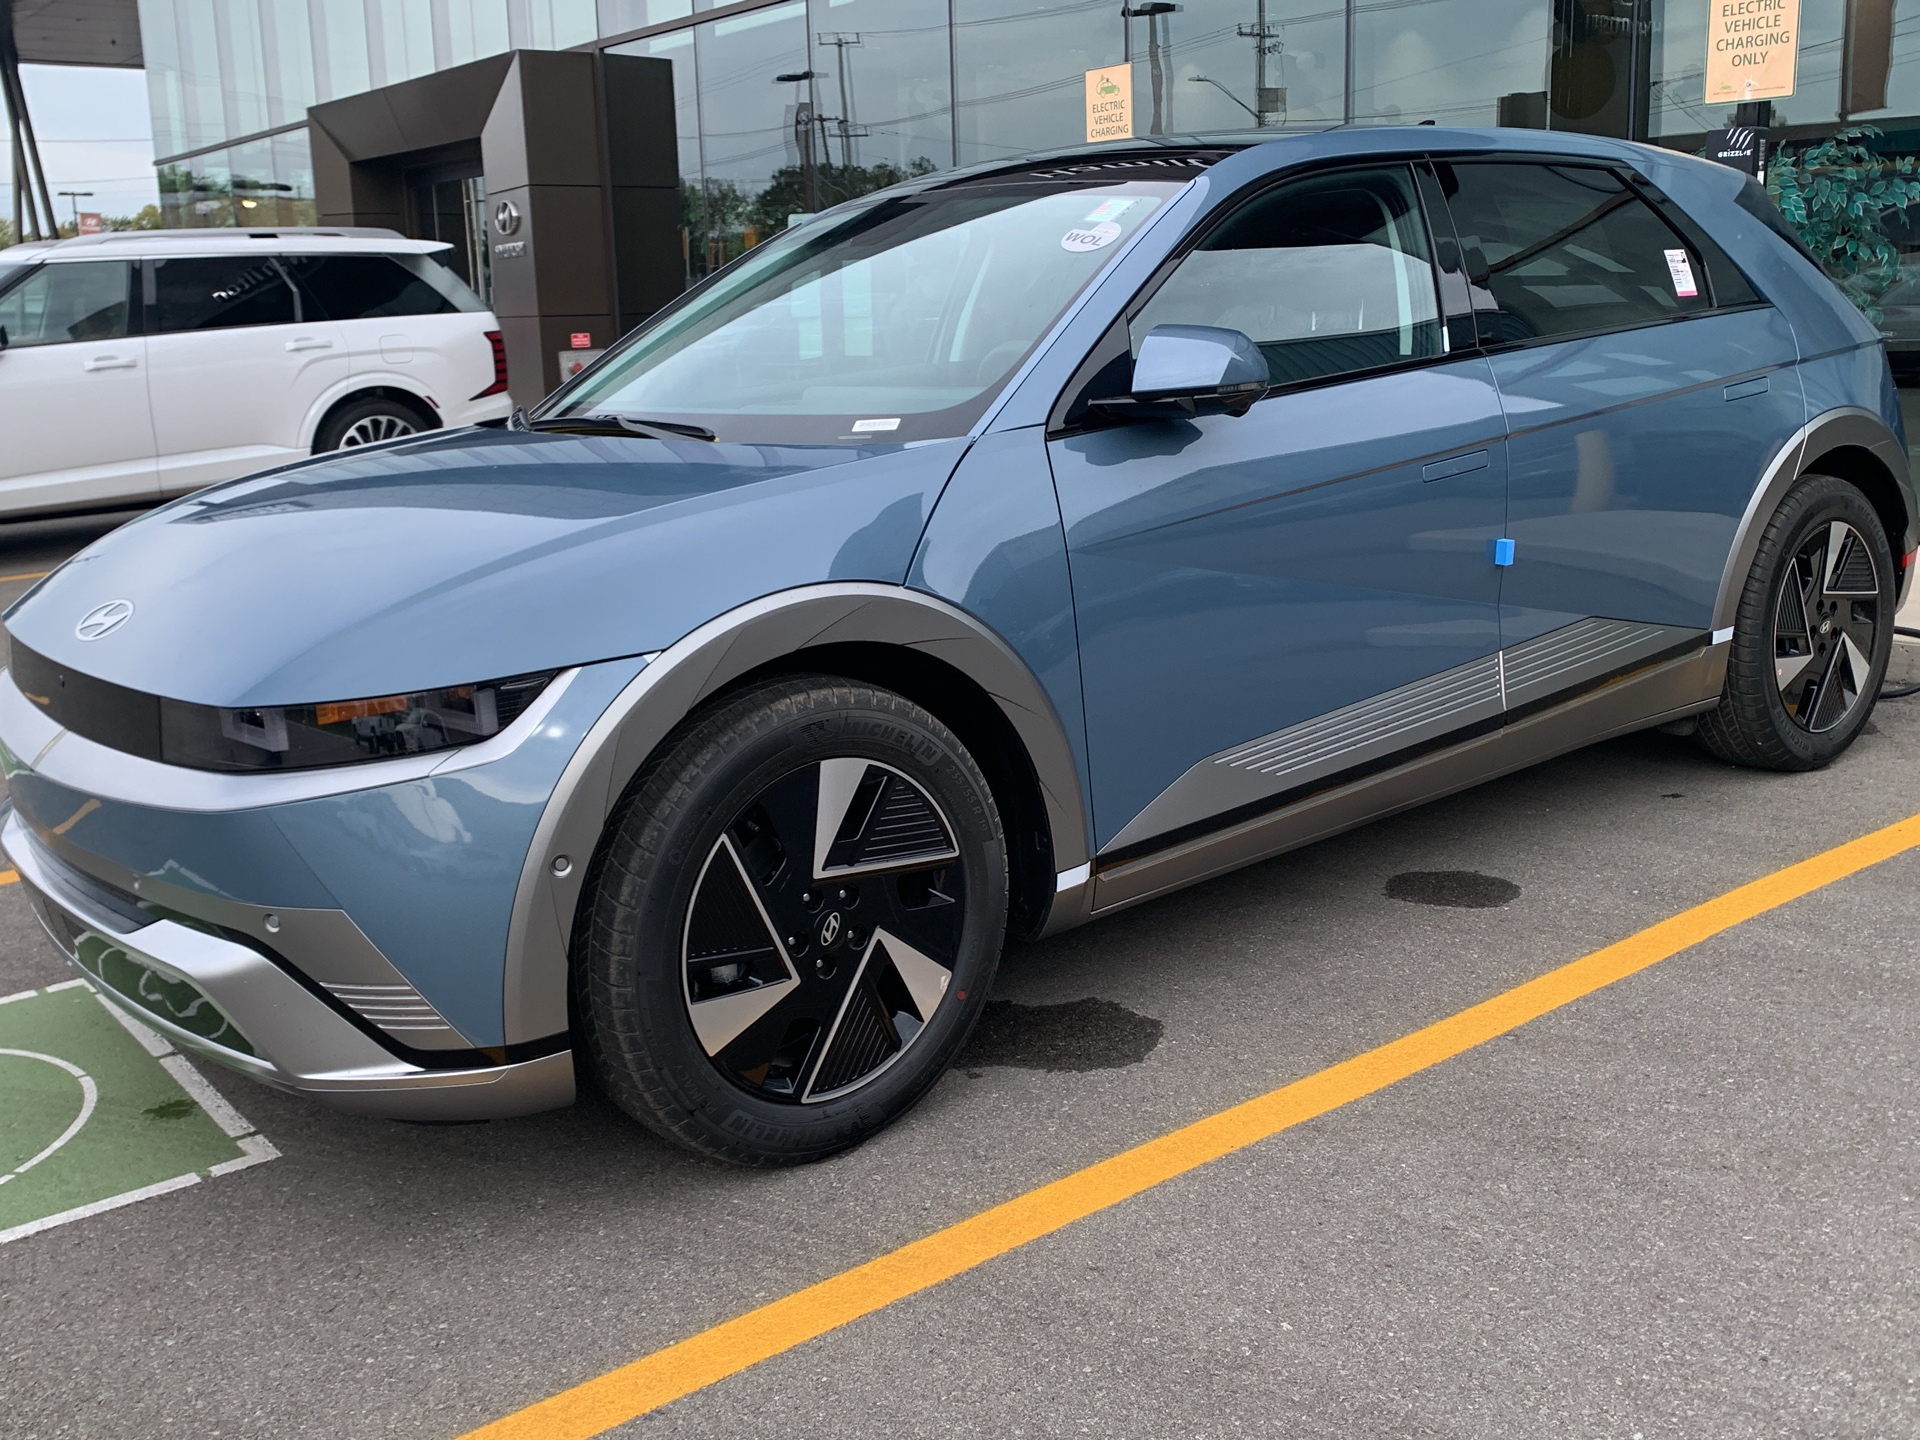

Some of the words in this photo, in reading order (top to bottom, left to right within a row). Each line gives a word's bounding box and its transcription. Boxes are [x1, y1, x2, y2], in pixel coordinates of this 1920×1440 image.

[1722, 0, 1785, 17] ELECTRIC
[1724, 14, 1781, 33] VEHICLE
[1716, 31, 1790, 51] CHARGING
[1731, 51, 1769, 67] ONLY
[1092, 99, 1125, 114] ELECTRIC
[1094, 112, 1124, 125] VEHICLE
[1090, 124, 1129, 139] CHARGING
[1065, 232, 1103, 247] WOL
[838, 720, 939, 763] MICHELIN
[945, 764, 977, 803] 235/55
[972, 806, 982, 815] R
[978, 819, 989, 832] 19
